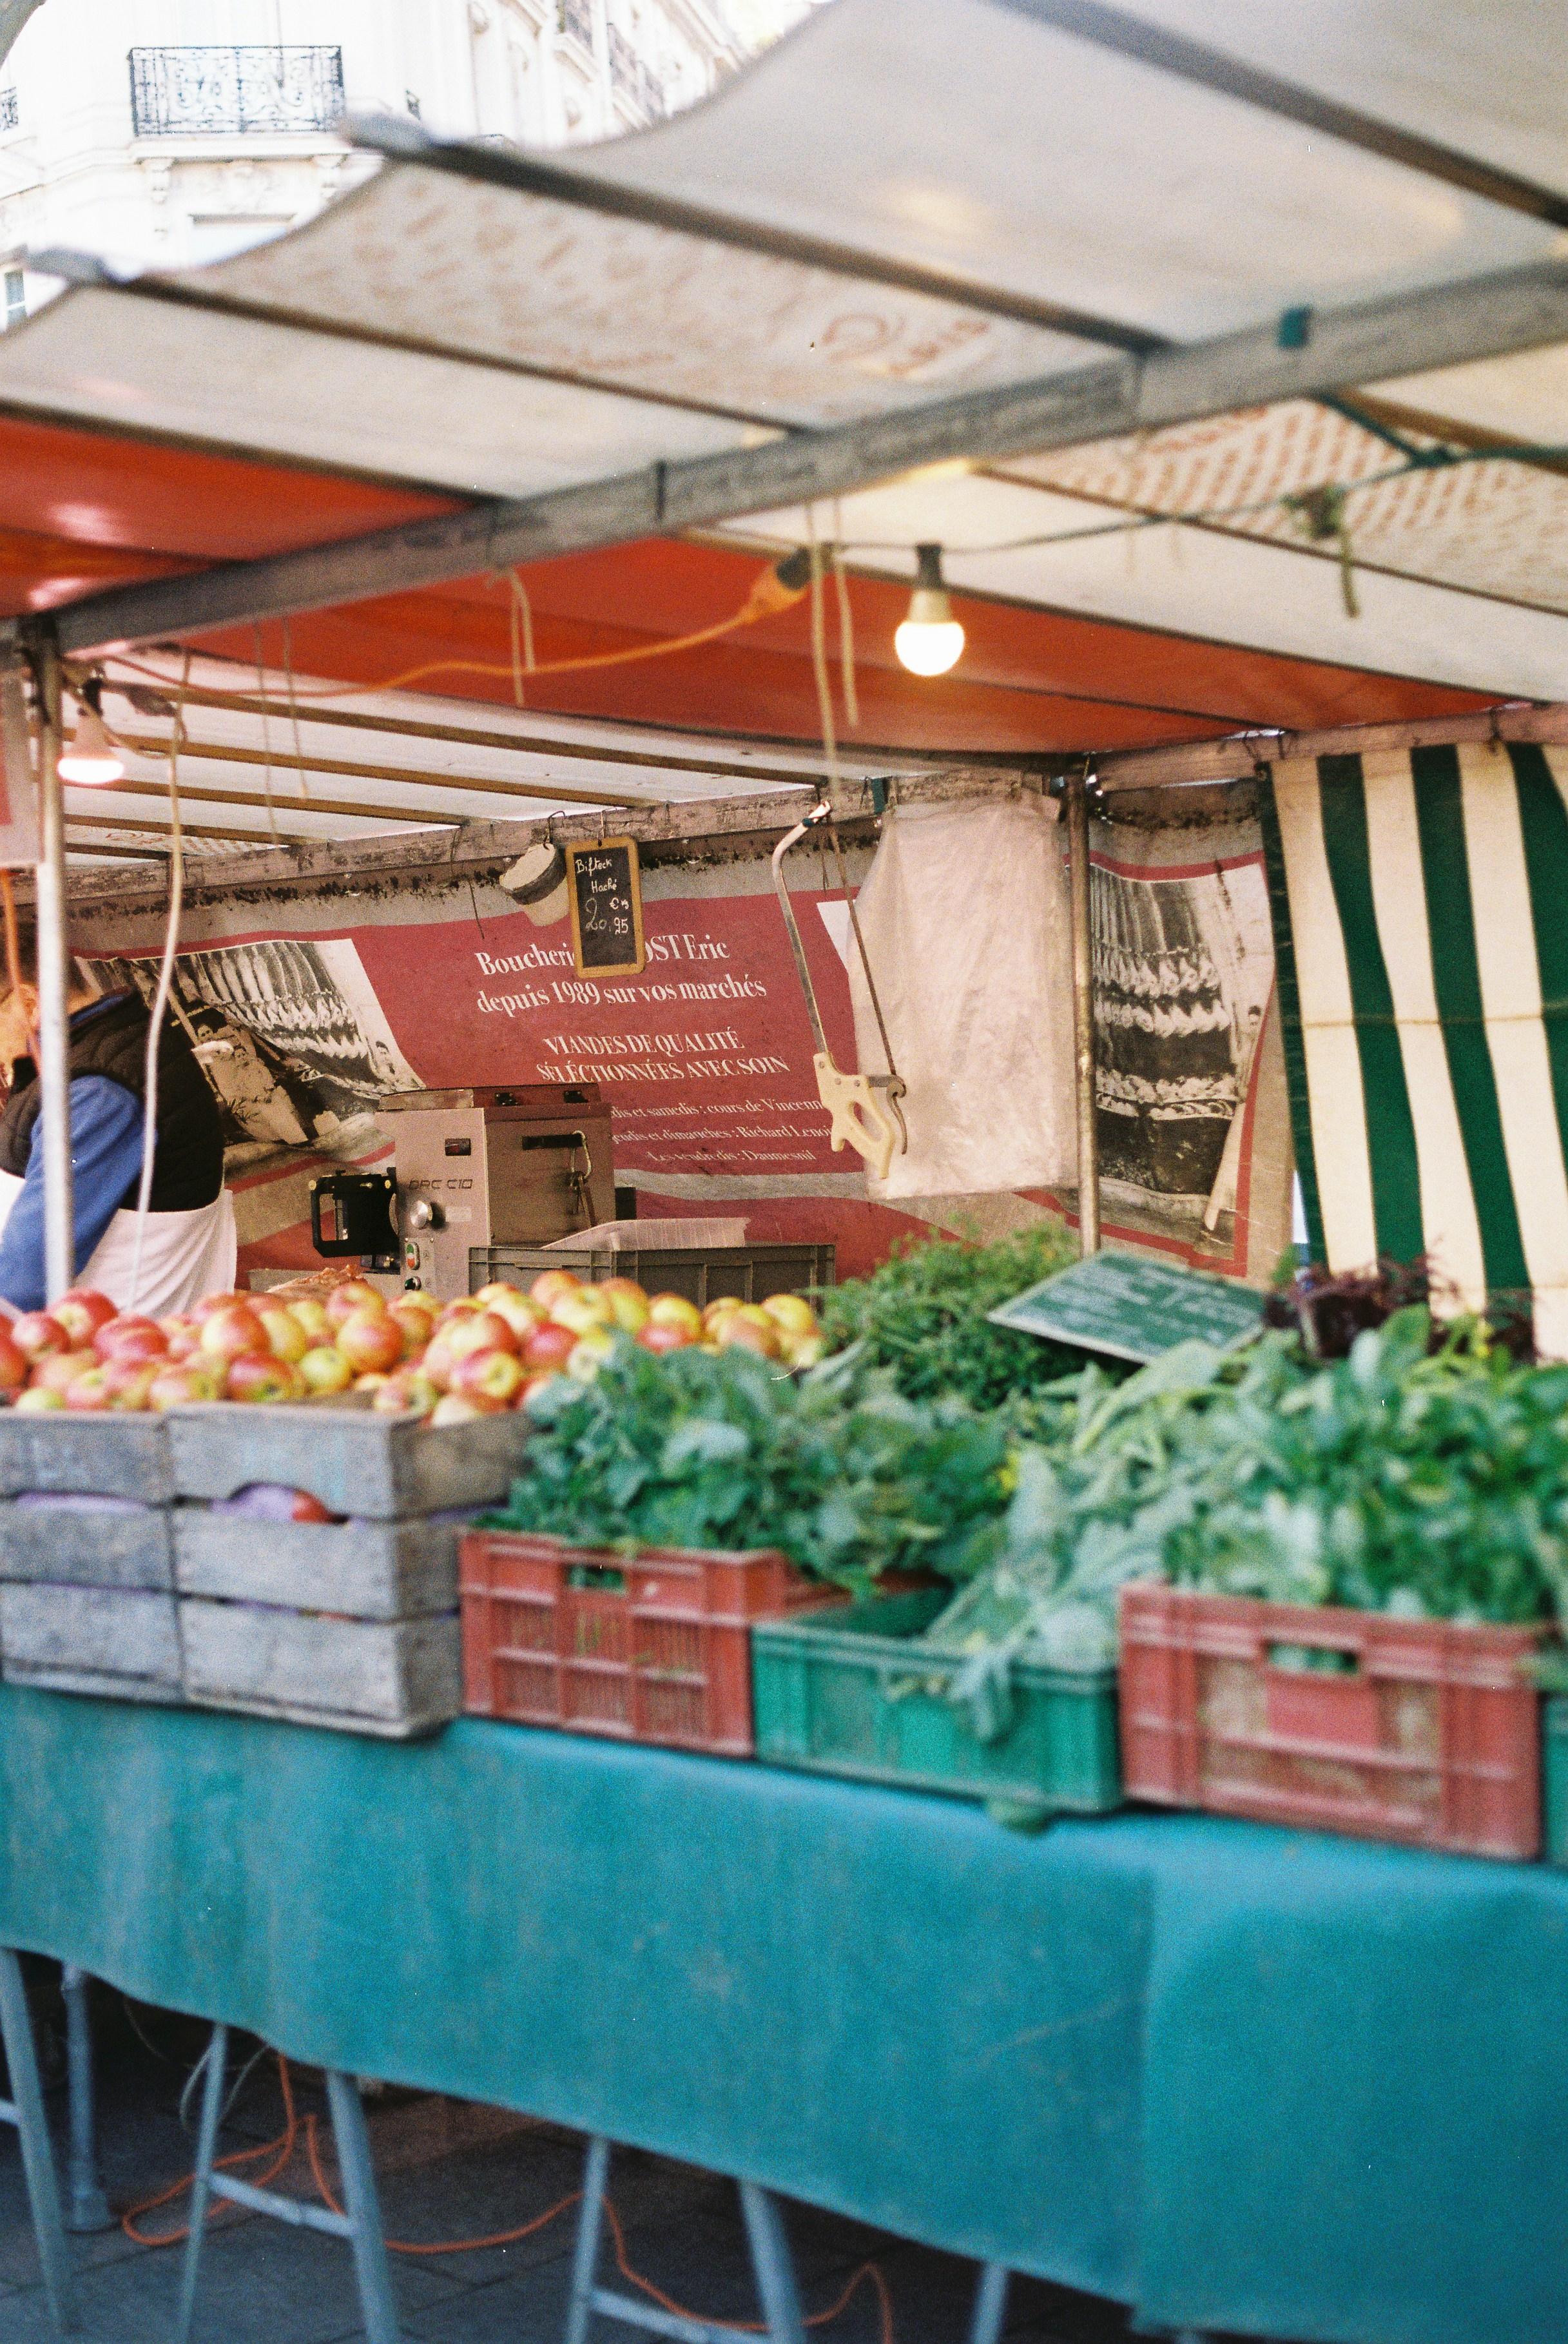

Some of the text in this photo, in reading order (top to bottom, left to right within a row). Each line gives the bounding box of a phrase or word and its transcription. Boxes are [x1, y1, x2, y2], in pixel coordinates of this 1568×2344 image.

[575, 857, 613, 877] Bifteck
[591, 877, 617, 894] Haché
[474, 934, 730, 976] Boucheri OST Eric
[477, 974, 768, 1018] depuis 1989 sur vos marchés
[543, 1026, 746, 1058] VIANDES DE QUALITÉ
[685, 1060, 740, 1079] AVEC
[736, 1056, 791, 1075] SOIN
[632, 1107, 647, 1118] et
[647, 1102, 699, 1117] samedis
[707, 1103, 746, 1115] cours
[745, 1099, 764, 1112] de
[760, 1098, 824, 1112] Vincenn
[648, 1131, 663, 1141] et
[663, 1127, 731, 1141] dimanches
[735, 1125, 792, 1138] Richard
[740, 1148, 817, 1161] Daumesnil
